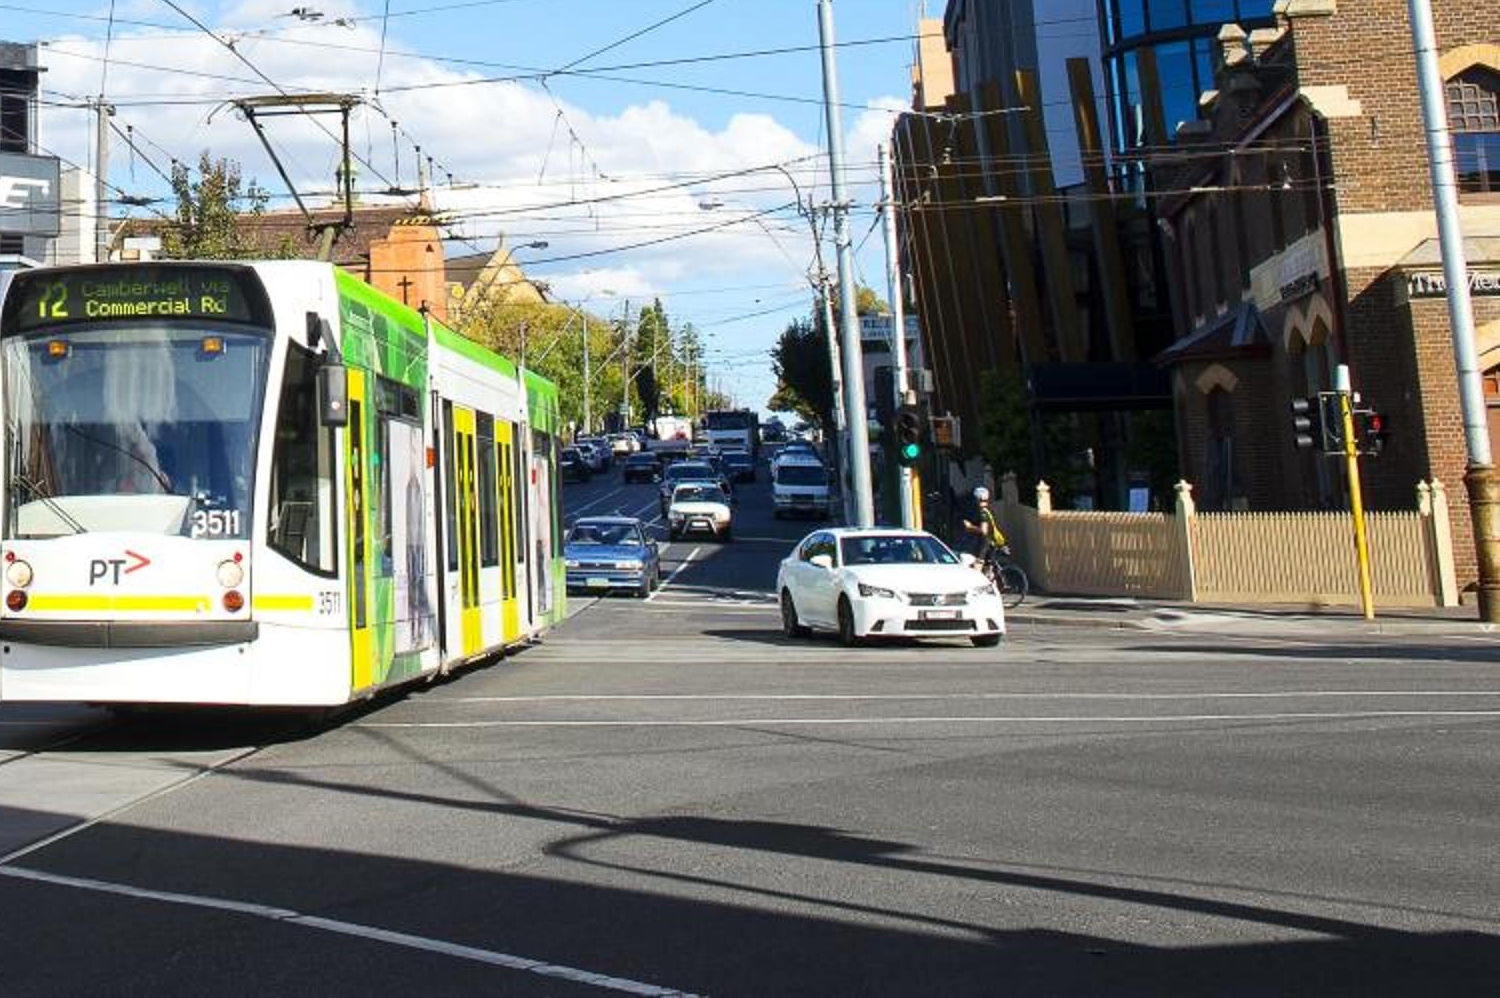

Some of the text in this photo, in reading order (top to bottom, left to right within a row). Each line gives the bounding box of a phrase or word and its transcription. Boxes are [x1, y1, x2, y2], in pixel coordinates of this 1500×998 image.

[37, 282, 68, 318] 72
[85, 298, 191, 317] Commercial
[192, 509, 240, 536] 3511
